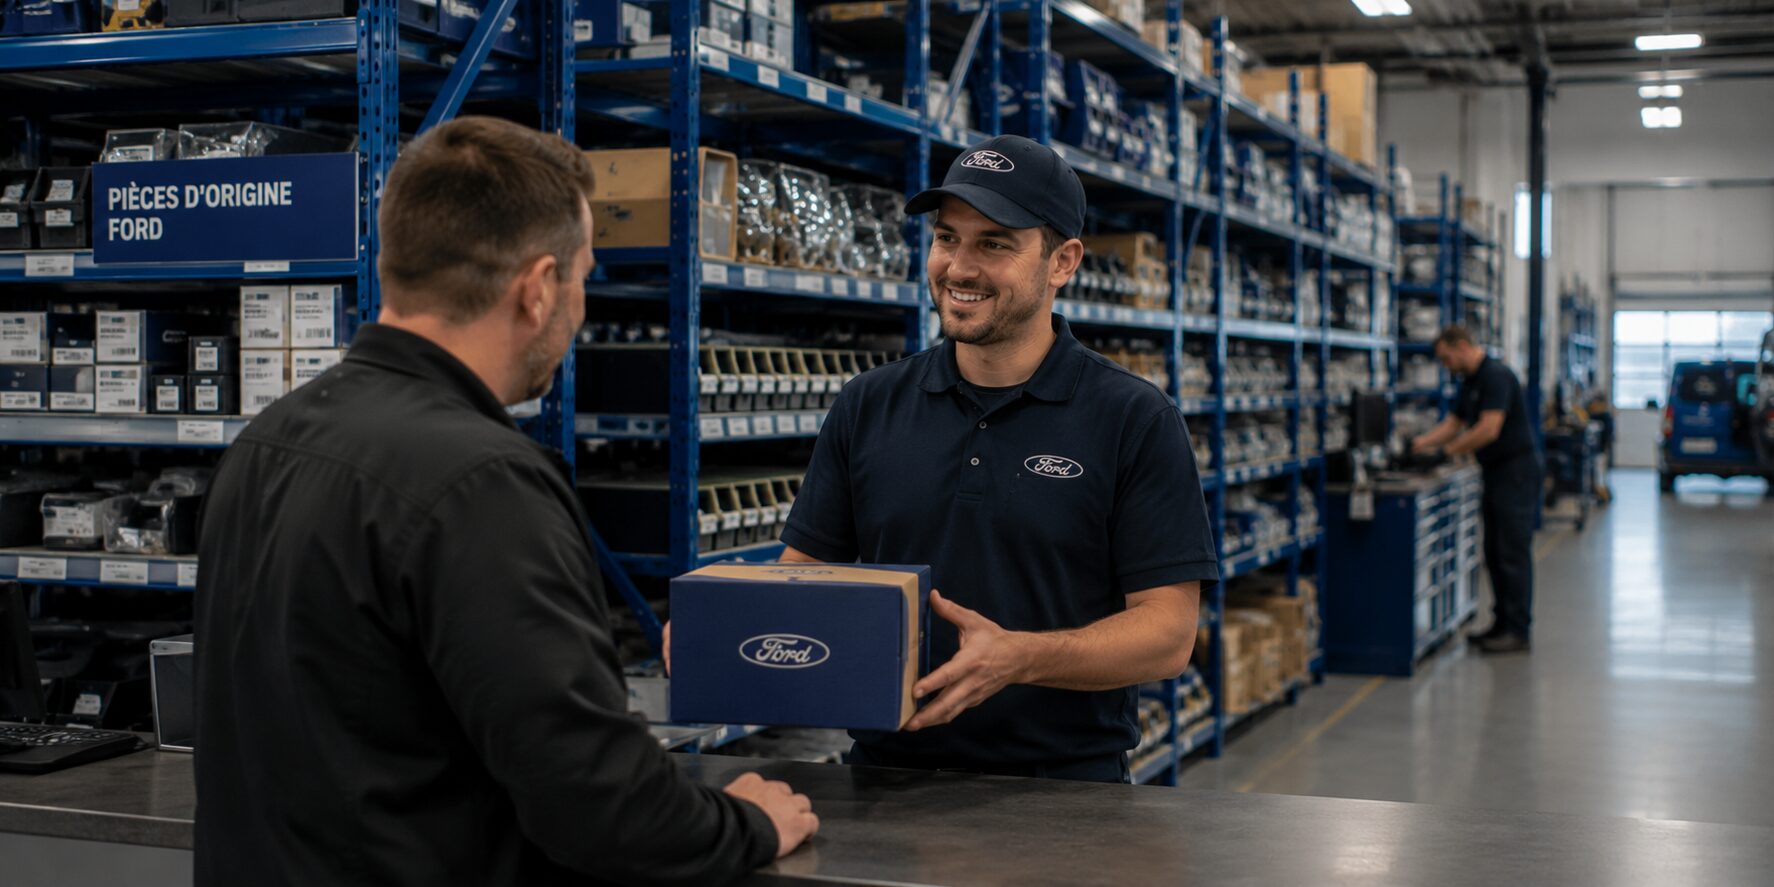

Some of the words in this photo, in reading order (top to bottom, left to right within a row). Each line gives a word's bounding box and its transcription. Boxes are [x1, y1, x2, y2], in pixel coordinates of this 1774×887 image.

[966, 151, 1005, 169] Ford
[108, 181, 179, 211] PIÈCES
[184, 181, 292, 209] D'ORIGINE
[108, 217, 163, 241] FORD
[1034, 457, 1072, 475] Ford
[755, 637, 812, 663] Ford
